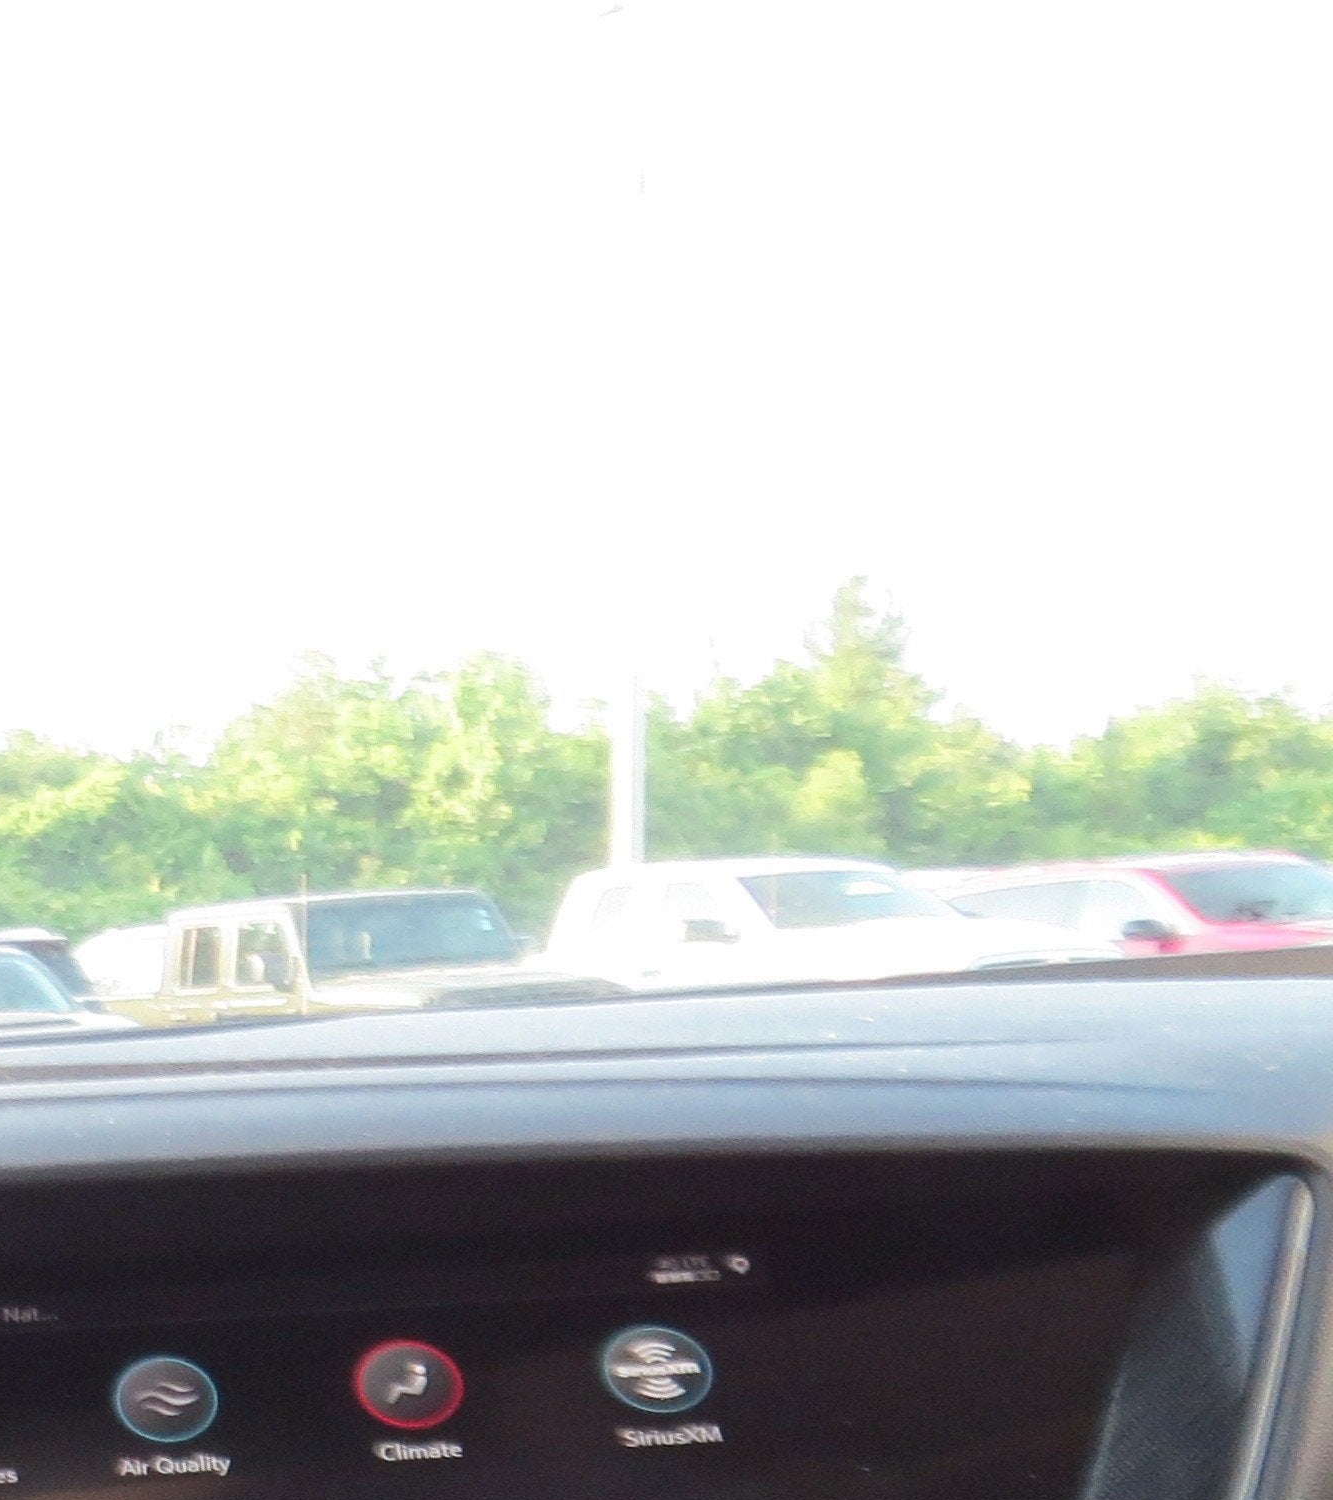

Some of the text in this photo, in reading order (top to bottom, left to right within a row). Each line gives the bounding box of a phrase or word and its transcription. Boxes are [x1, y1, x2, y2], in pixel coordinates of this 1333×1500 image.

[617, 1423, 724, 1449] SiriusXM
[373, 1440, 464, 1462] Climate
[116, 1453, 231, 1478] Air Quality
